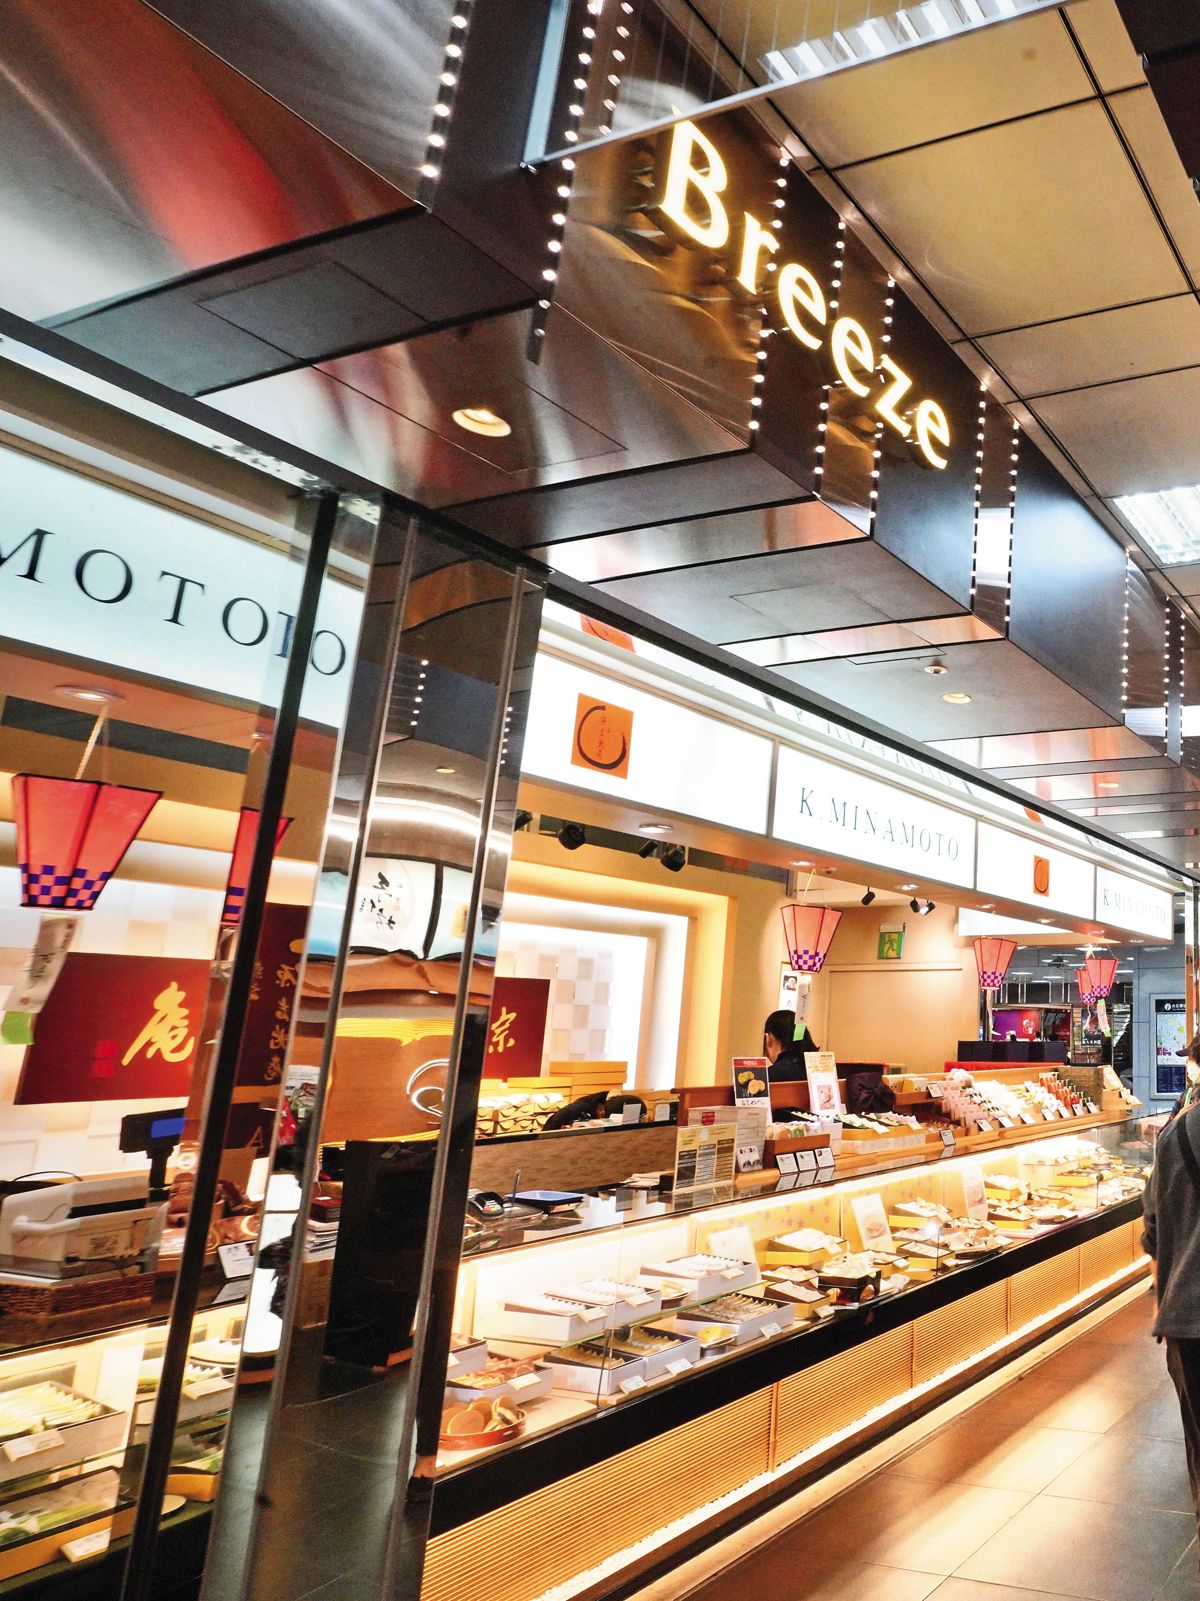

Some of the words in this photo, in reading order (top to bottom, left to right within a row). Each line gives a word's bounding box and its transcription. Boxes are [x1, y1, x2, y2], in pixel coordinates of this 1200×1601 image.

[658, 104, 951, 470] Breeze
[799, 787, 959, 861] K.MINAMOTO
[121, 981, 195, 1066] 庵
